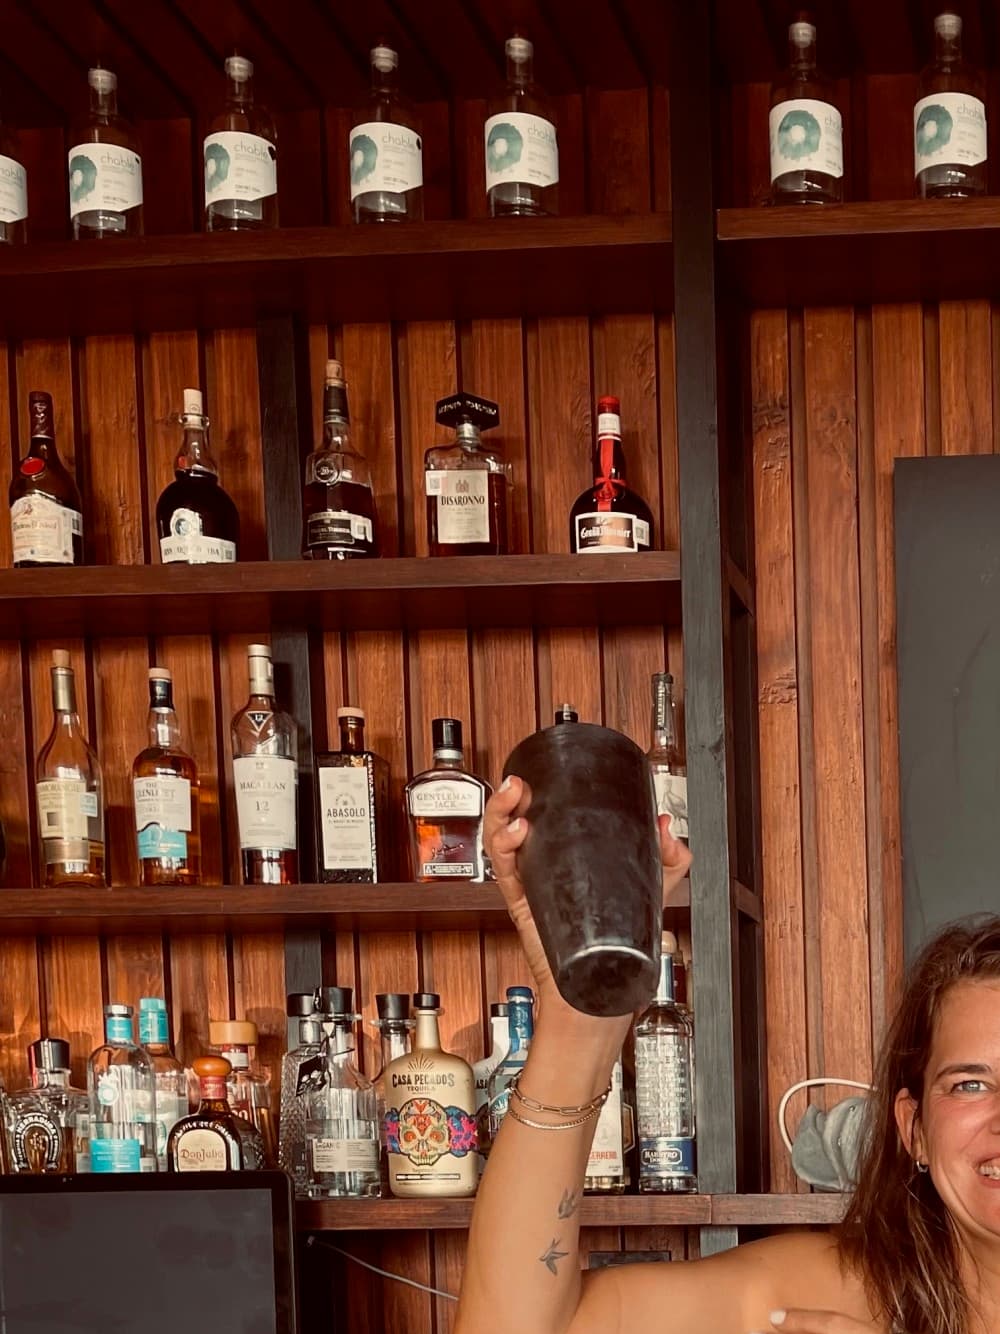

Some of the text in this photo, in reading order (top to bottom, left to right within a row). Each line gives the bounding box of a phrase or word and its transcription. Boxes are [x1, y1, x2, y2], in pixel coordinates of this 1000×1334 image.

[441, 495, 485, 506] DISARONNO
[240, 781, 287, 791] MACALLAN
[416, 792, 474, 802] GENTLEMAN
[255, 800, 271, 812] 12
[434, 800, 457, 809] JACK
[327, 807, 367, 818] ABASOLO
[391, 1072, 456, 1089] CASA PECADOS
